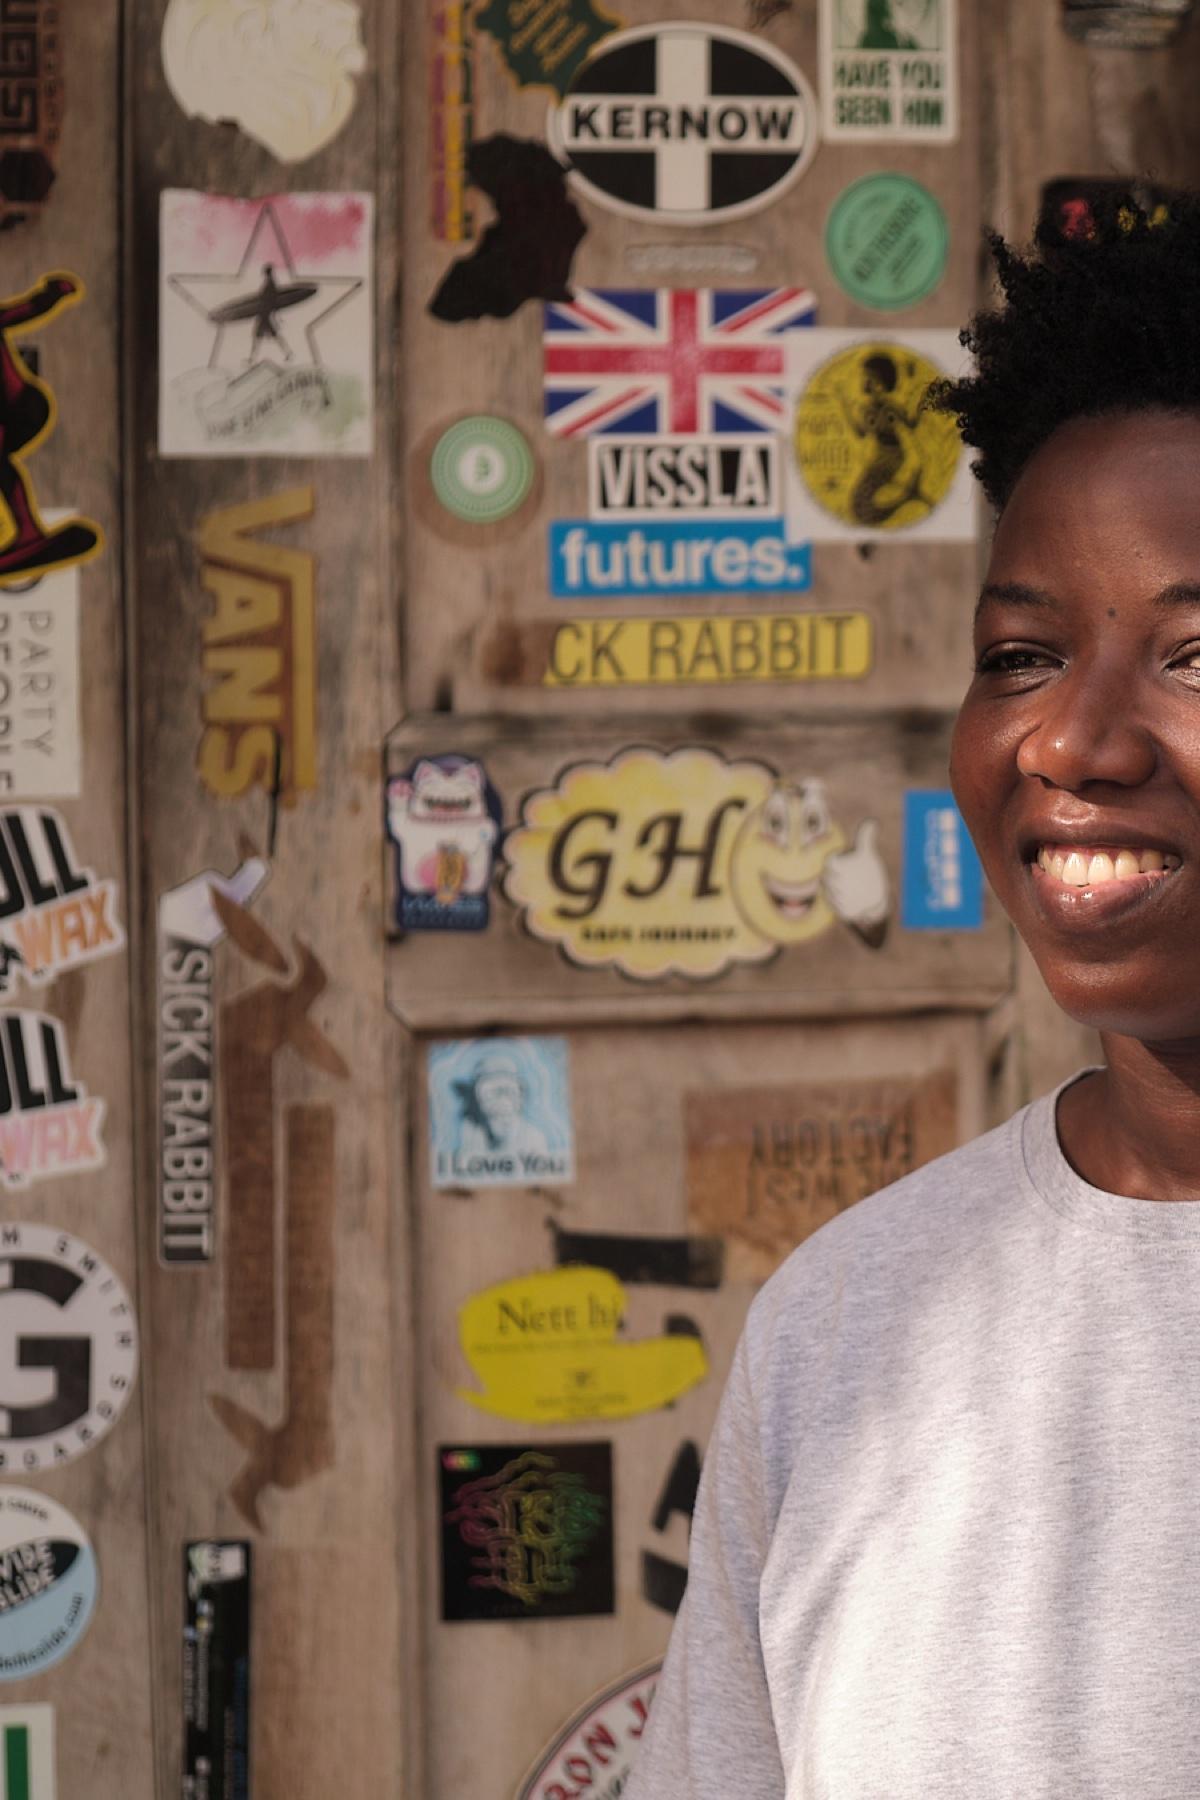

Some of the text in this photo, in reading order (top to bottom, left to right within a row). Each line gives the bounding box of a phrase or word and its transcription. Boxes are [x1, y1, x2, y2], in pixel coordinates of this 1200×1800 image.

[834, 55, 943, 91] HAVE YOU
[570, 104, 795, 142] KERNOW
[834, 98, 944, 128] SEEN HIM
[601, 443, 770, 507] VISSLA
[560, 528, 804, 588] futures.
[200, 486, 314, 798] VANS
[549, 615, 856, 684] CK RABBIT
[19, 609, 54, 758] PARTY
[547, 797, 748, 921] GH
[12, 888, 116, 970] WAX
[161, 944, 214, 1256] SICK RABBIT
[752, 1103, 915, 1168] FACTORY
